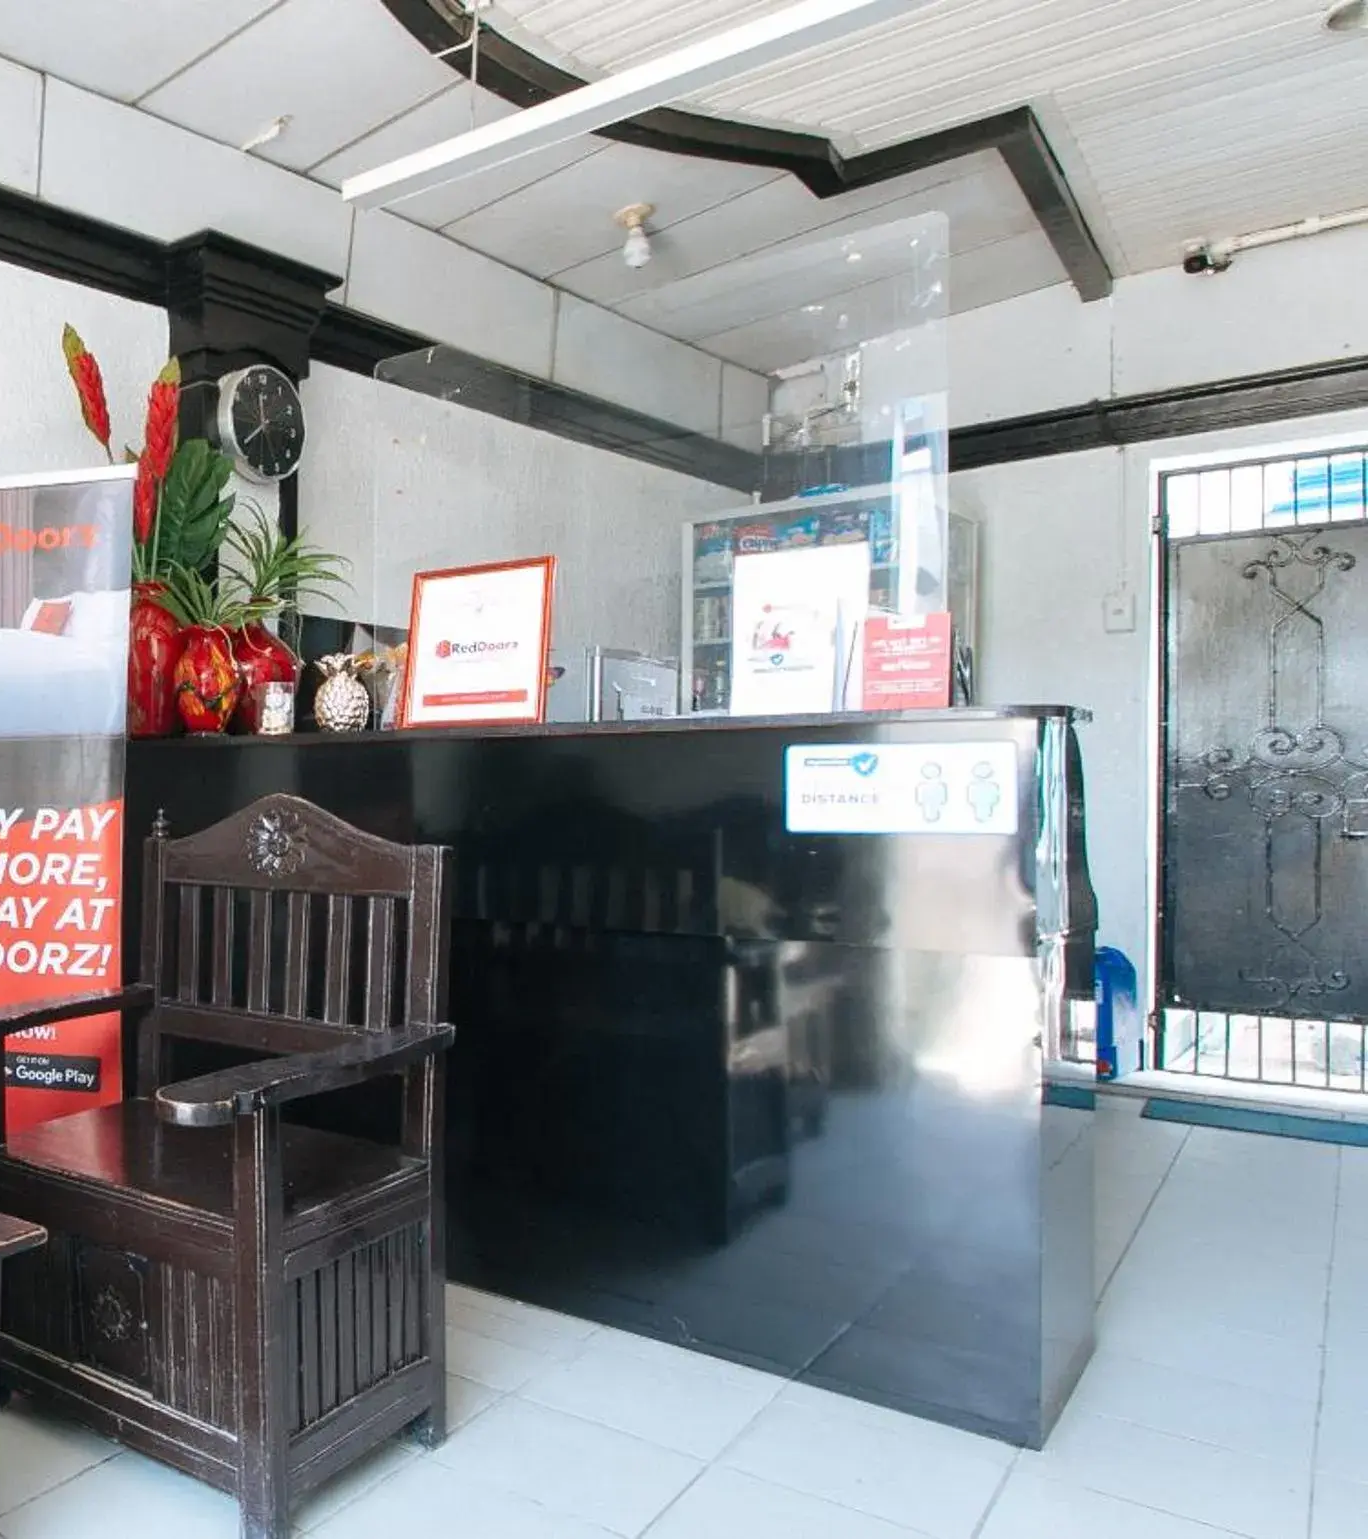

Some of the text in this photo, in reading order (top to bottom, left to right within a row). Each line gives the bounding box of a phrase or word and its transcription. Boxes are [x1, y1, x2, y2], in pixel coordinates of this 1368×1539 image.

[31, 808, 115, 842] PAY
[54, 897, 115, 932] AT
[15, 1064, 95, 1088] Google Play
